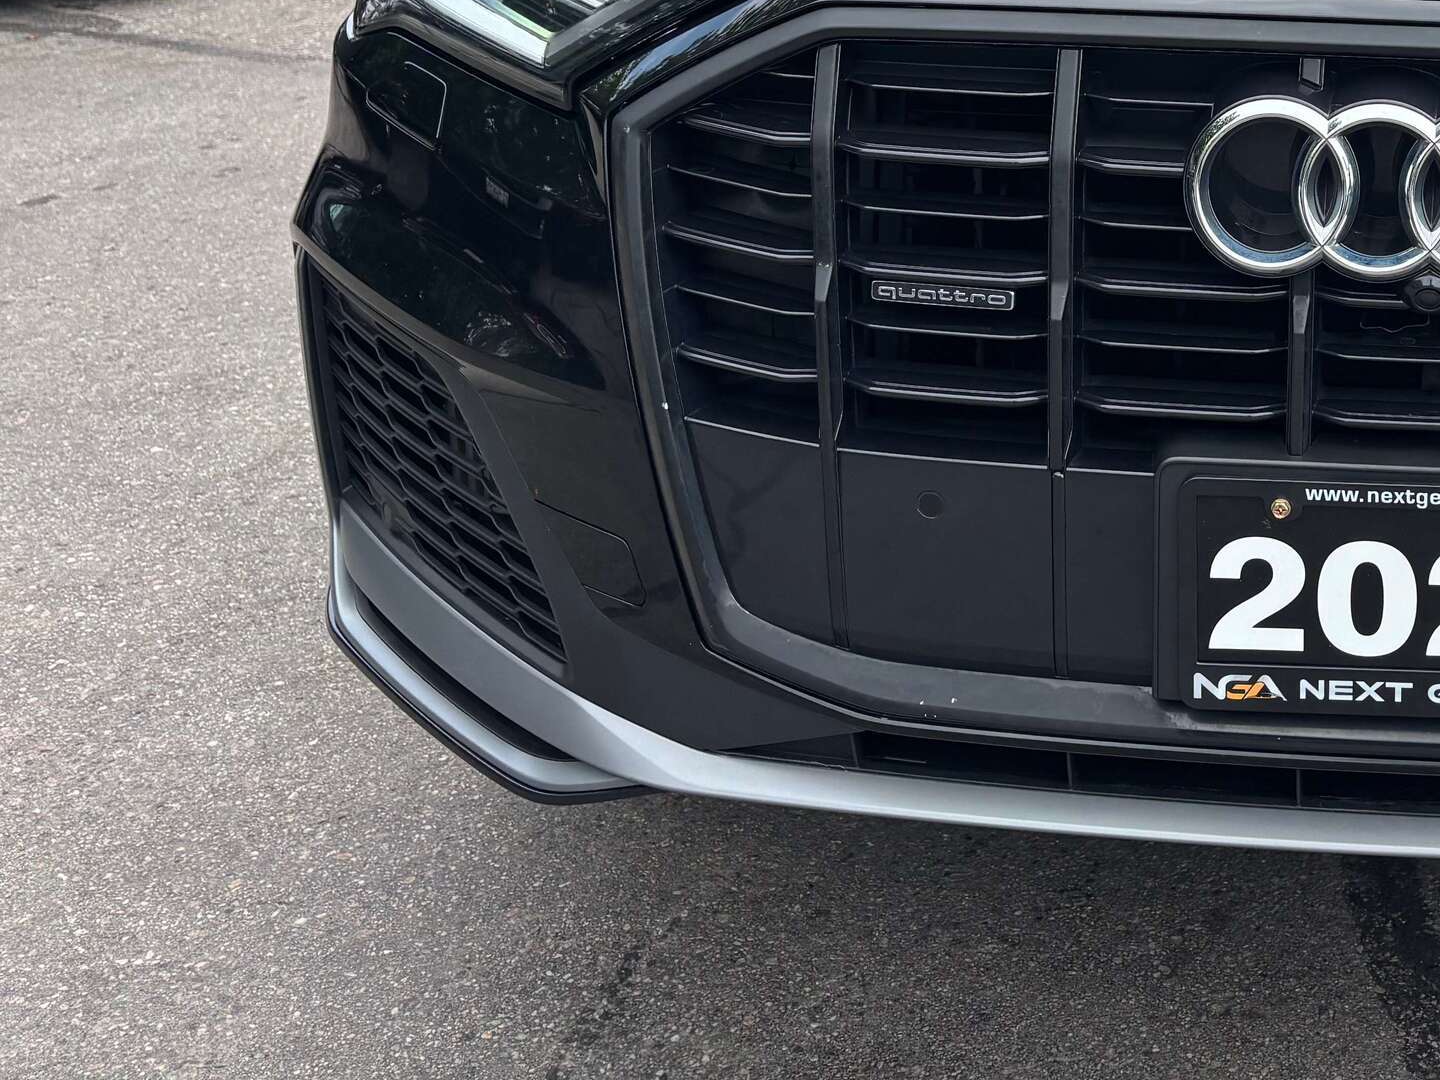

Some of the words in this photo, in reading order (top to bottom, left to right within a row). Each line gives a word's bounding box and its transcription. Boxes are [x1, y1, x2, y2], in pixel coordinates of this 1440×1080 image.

[877, 285, 1007, 305] quattro
[1193, 672, 1288, 702] NGA
[1299, 678, 1414, 703] NEXT
